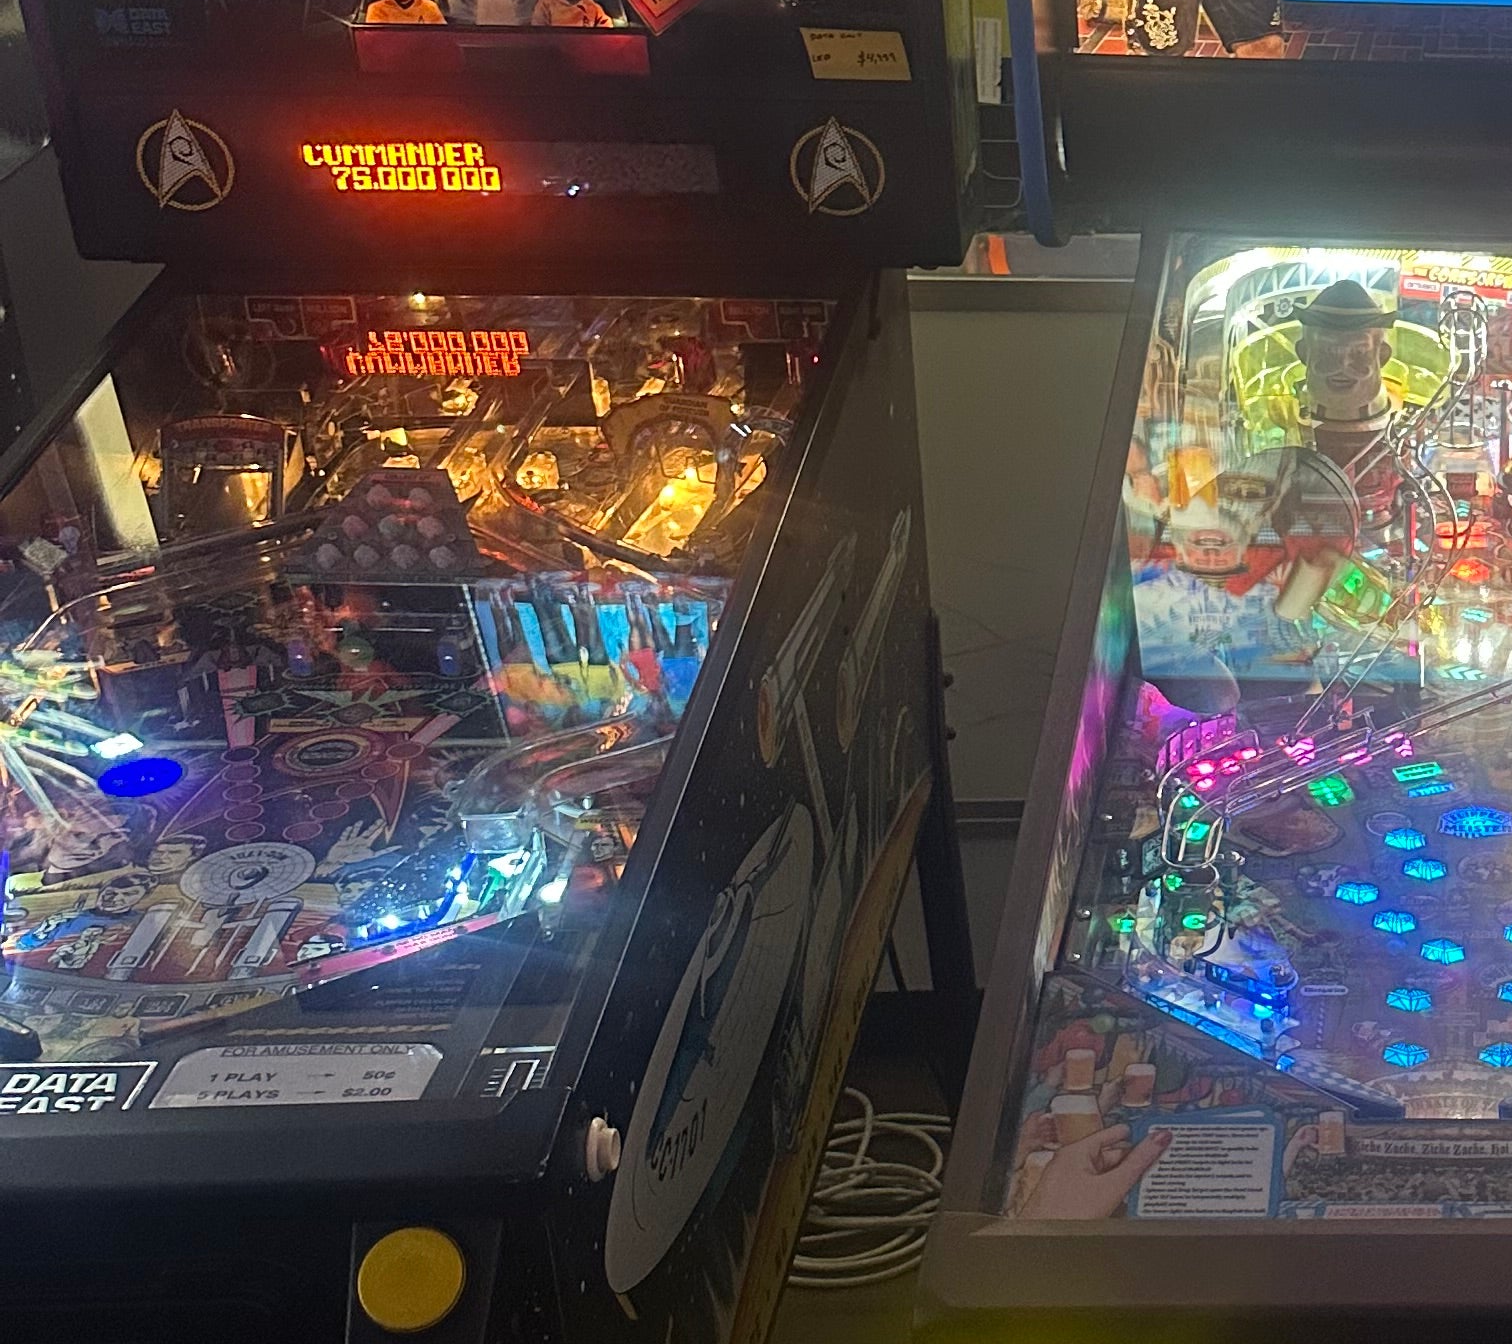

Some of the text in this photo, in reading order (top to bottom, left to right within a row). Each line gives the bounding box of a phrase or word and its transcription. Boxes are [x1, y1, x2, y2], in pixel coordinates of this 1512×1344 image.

[221, 1043, 415, 1057] FOR AMUSEMENT ONLY
[3, 1073, 119, 1094] DATA
[209, 1072, 218, 1084] 1
[223, 1071, 278, 1084] PLAY
[213, 1088, 281, 1101] PLAYS
[342, 1086, 392, 1099] $2.00
